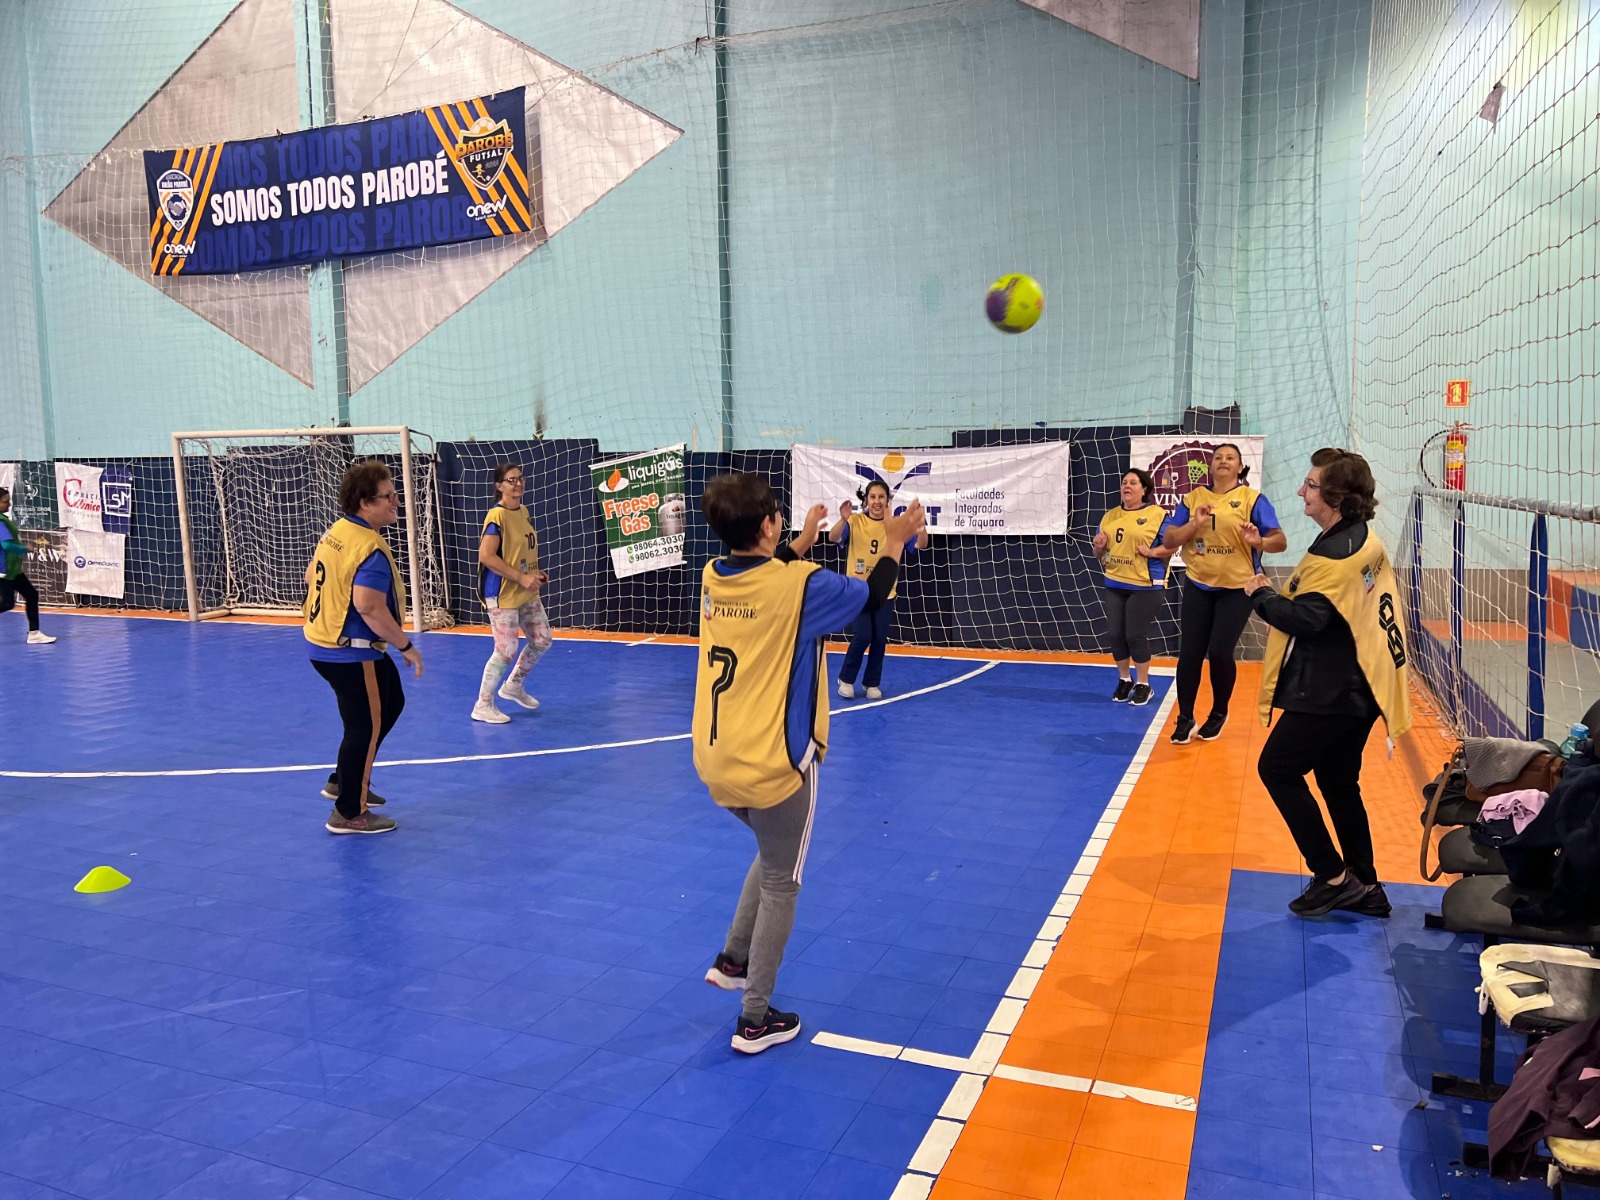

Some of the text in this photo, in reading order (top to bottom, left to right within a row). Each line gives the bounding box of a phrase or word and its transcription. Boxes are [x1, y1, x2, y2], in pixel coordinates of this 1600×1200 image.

[274, 128, 362, 182] TODOS
[455, 129, 513, 160] PAROBÉ
[469, 151, 503, 162] FUTSAL
[210, 149, 449, 226] SOMOS TODOS PAROBÉ
[466, 194, 507, 217] onew
[280, 212, 366, 262] TODOS
[955, 487, 1004, 500] Faculdades
[603, 493, 659, 520] Freese
[955, 501, 1002, 515] Integradas
[621, 511, 651, 536] Gás
[955, 515, 965, 527] de
[968, 515, 1004, 530] Taquara
[525, 532, 535, 550] 10
[870, 539, 879, 555] 9
[1115, 528, 1125, 544] 6
[309, 560, 326, 624] 3
[713, 605, 757, 619] PAROBÉ
[707, 644, 739, 746] 7
